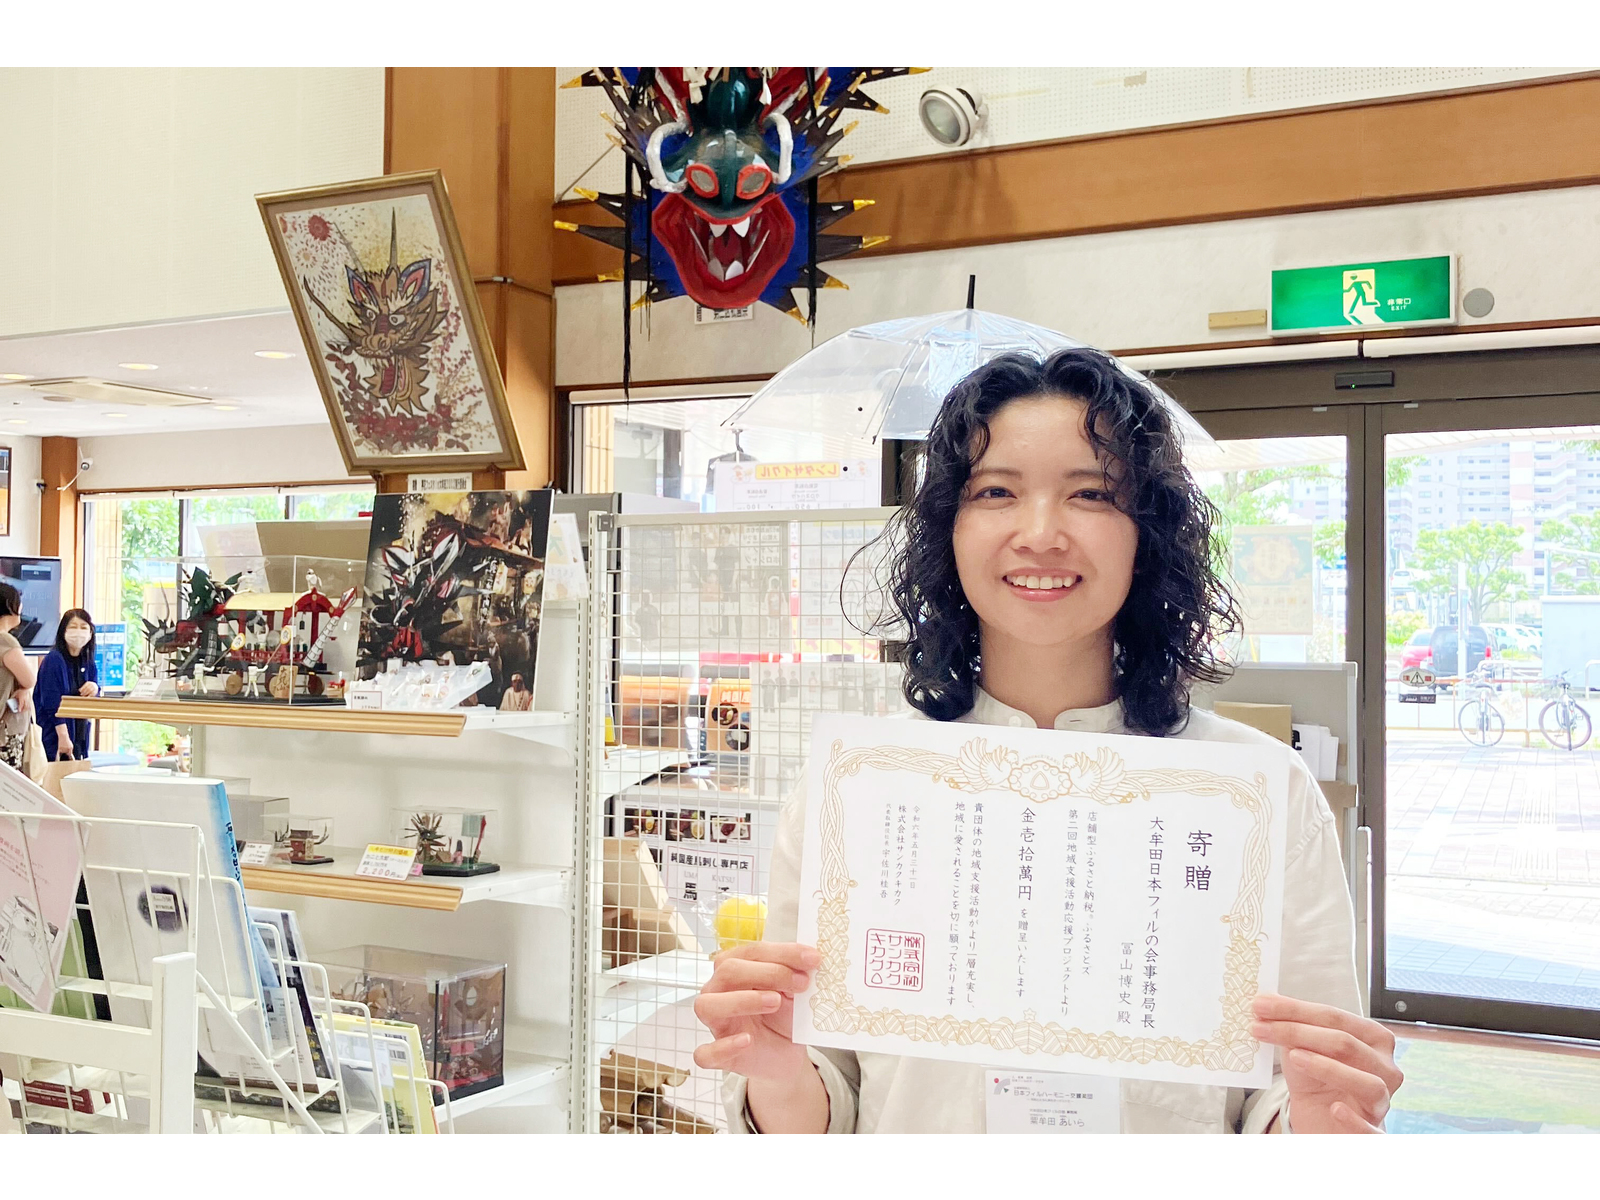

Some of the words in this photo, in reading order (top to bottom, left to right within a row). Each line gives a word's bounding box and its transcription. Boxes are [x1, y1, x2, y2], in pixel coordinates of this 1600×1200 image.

[1387, 297, 1411, 305] 非常口
[894, 804, 907, 906] 株式会社サンカクキカク
[909, 805, 920, 889] 令和六年五月三十一日
[1018, 806, 1036, 901] 金壱拾萬円
[1184, 829, 1213, 891] 寄贈
[946, 801, 966, 1006] 地域に愛されることを切に願っております
[1060, 809, 1078, 1016] 第二回地域支援活動応援プロジェクトより
[1140, 816, 1164, 1029] 大牟田日本フィルの会事務局長
[1016, 908, 1028, 997] を贈呈いたします
